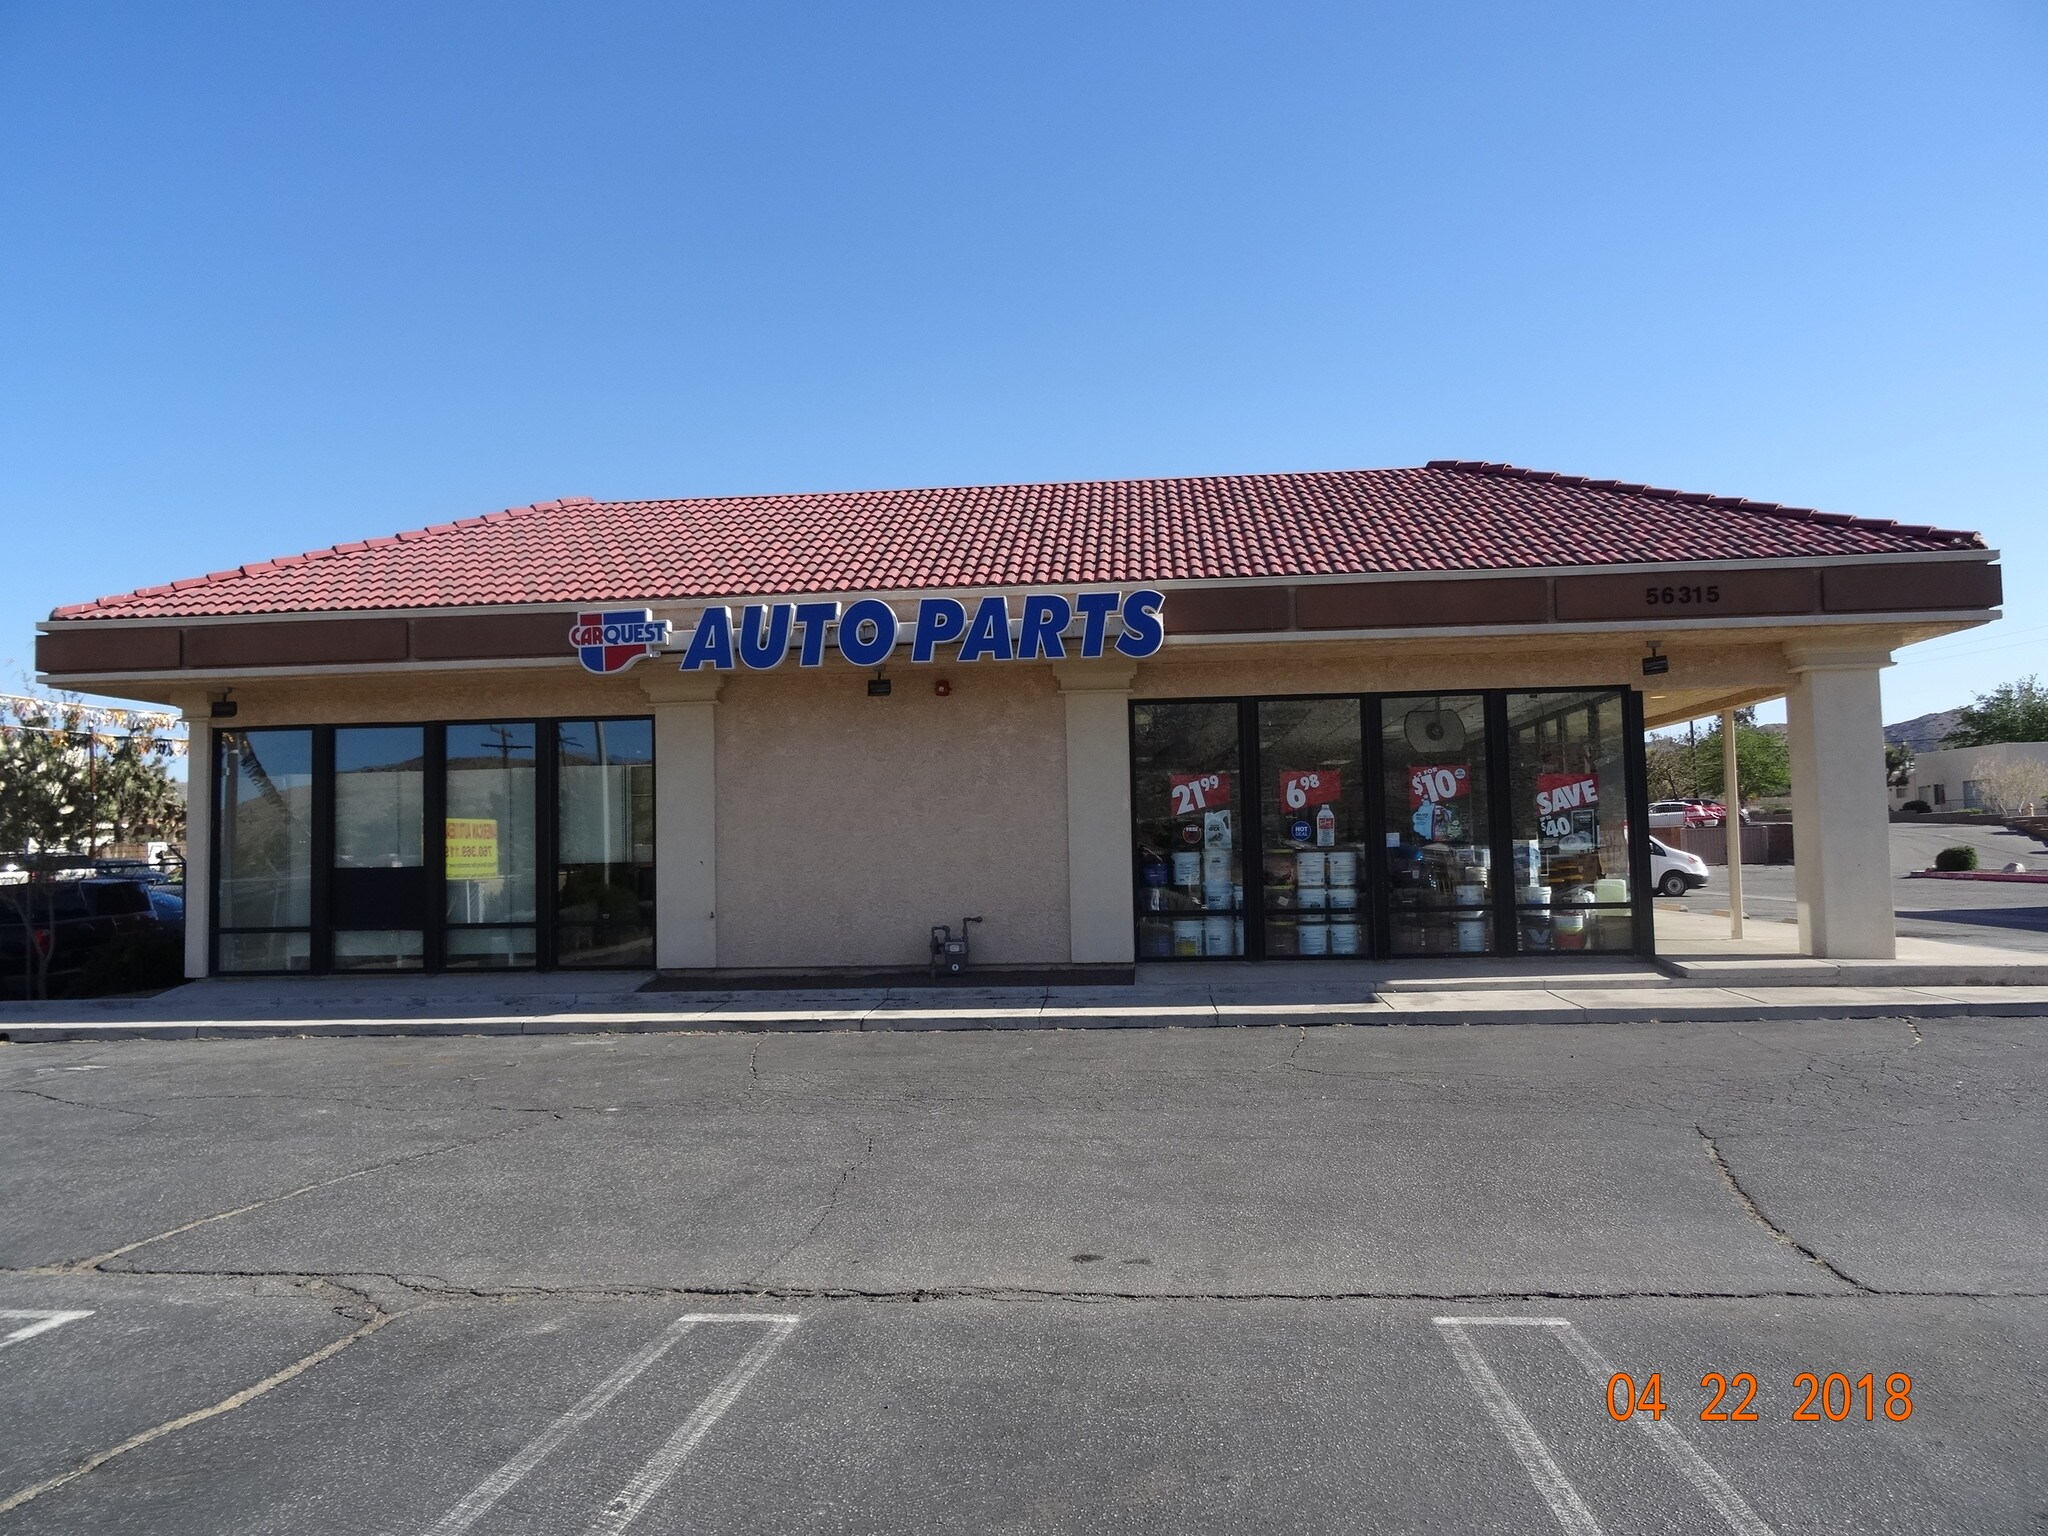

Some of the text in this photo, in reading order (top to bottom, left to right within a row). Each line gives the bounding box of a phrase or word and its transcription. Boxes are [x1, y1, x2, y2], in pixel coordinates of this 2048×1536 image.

[1645, 585, 1720, 605] 56315
[570, 622, 667, 646] CARQUEST
[679, 589, 1166, 671] AUTO PARTS
[1411, 769, 1457, 803] $10
[1536, 779, 1599, 815] SAVE
[1540, 816, 1571, 838] $40
